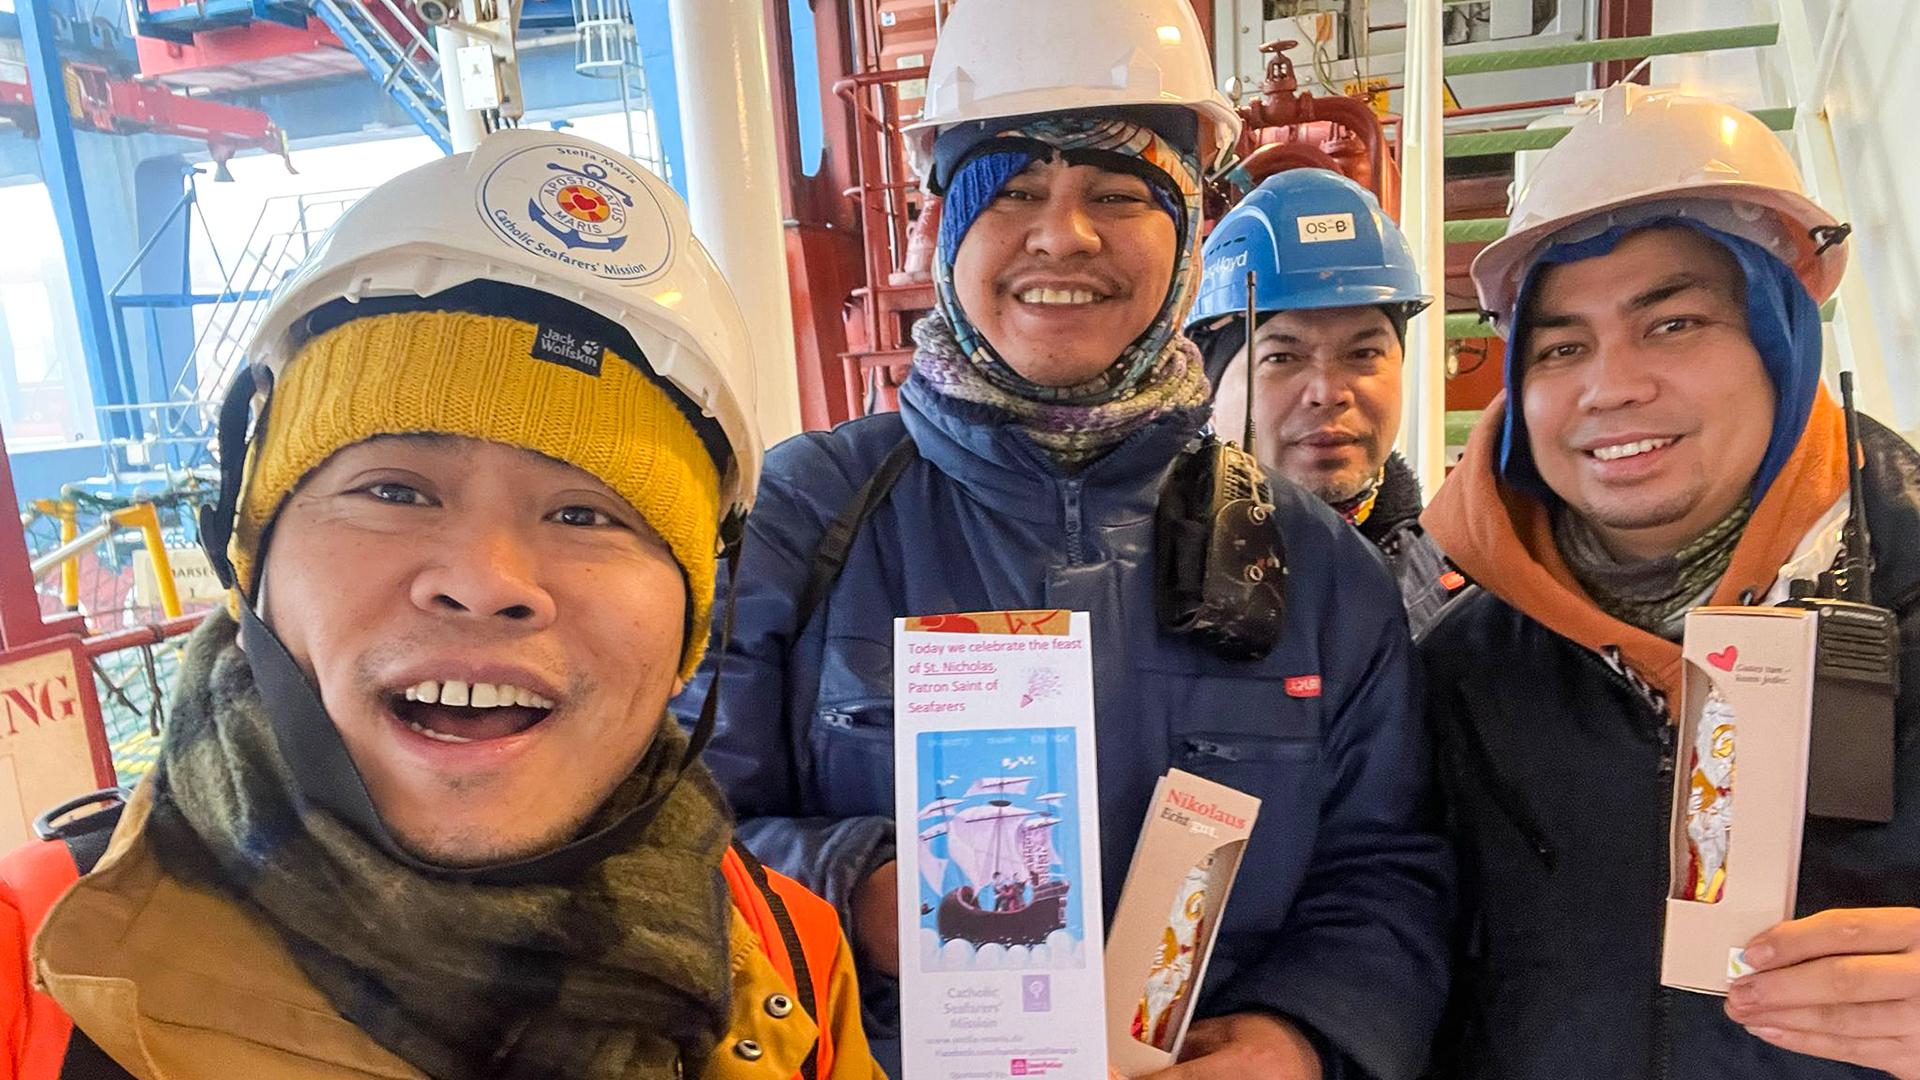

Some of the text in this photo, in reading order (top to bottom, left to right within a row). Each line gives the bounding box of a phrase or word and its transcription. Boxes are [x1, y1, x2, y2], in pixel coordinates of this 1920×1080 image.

[556, 147, 637, 184] Stella Maris
[544, 177, 624, 225] APOSTOLATUS
[553, 211, 603, 235] MARIS
[1305, 220, 1348, 235] OS-B
[494, 209, 535, 247] Catholic
[603, 263, 647, 276] Mission
[542, 328, 576, 347] Jack
[541, 338, 598, 368] Wolfskin
[908, 638, 1082, 656] Today we celebrate the feast
[908, 662, 922, 674] of
[923, 662, 940, 674] St.
[908, 679, 999, 694] Patron Saint of
[0, 675, 76, 736] NG
[907, 701, 966, 714] Seafarers
[1160, 807, 1190, 827] Echt
[1166, 788, 1246, 830] Nikolaus
